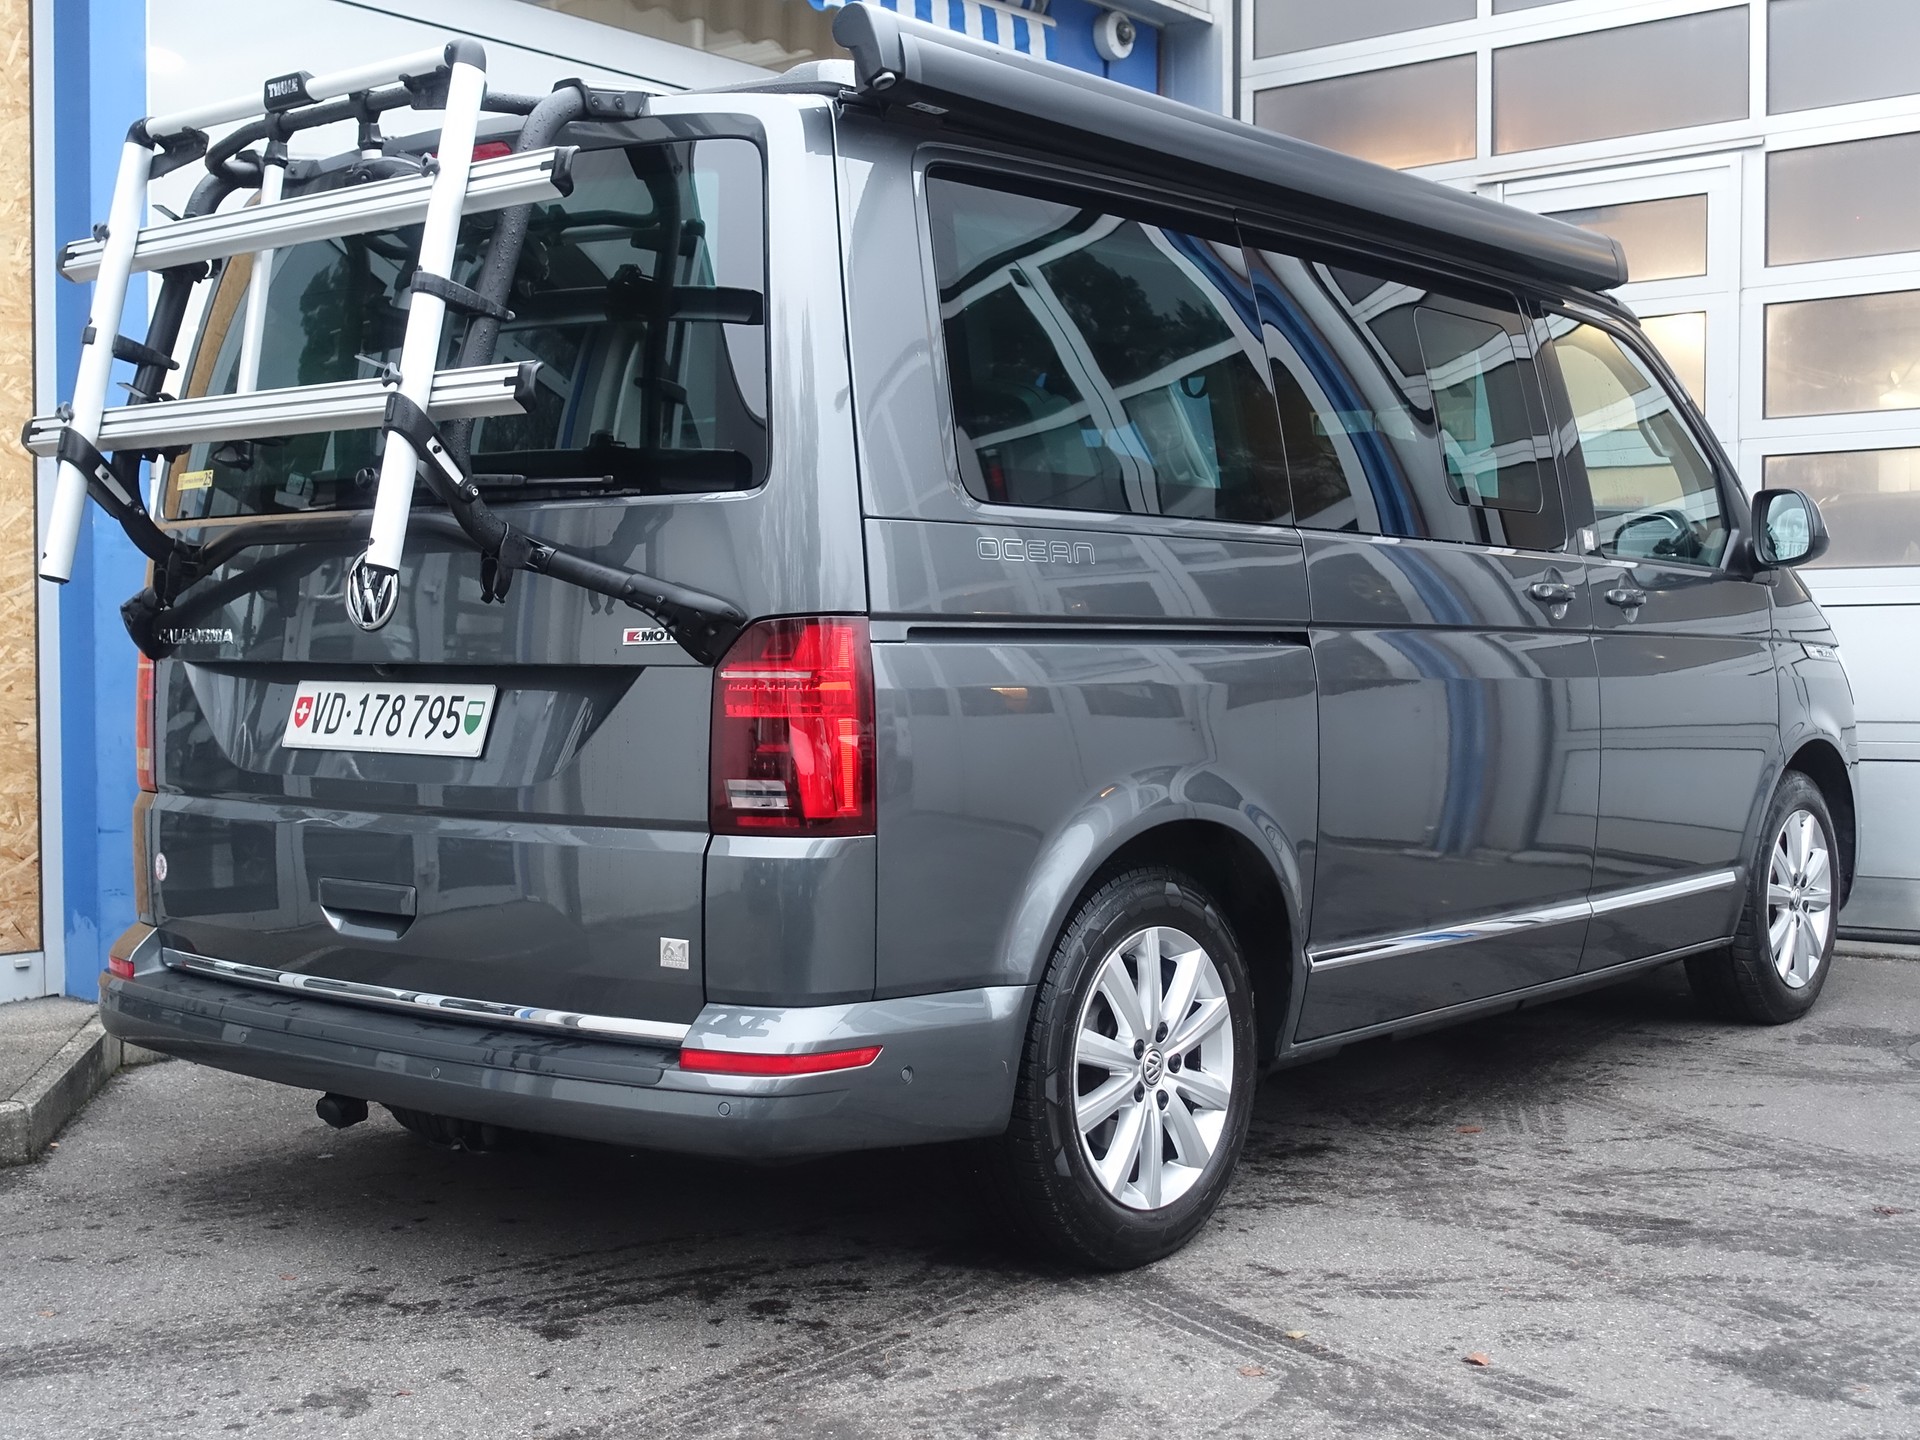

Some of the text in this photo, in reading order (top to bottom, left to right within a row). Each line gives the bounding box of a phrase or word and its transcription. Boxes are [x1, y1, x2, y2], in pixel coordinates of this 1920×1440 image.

[267, 77, 299, 98] THULE
[976, 536, 1095, 564] OCEAN
[628, 630, 673, 642] 4MOT
